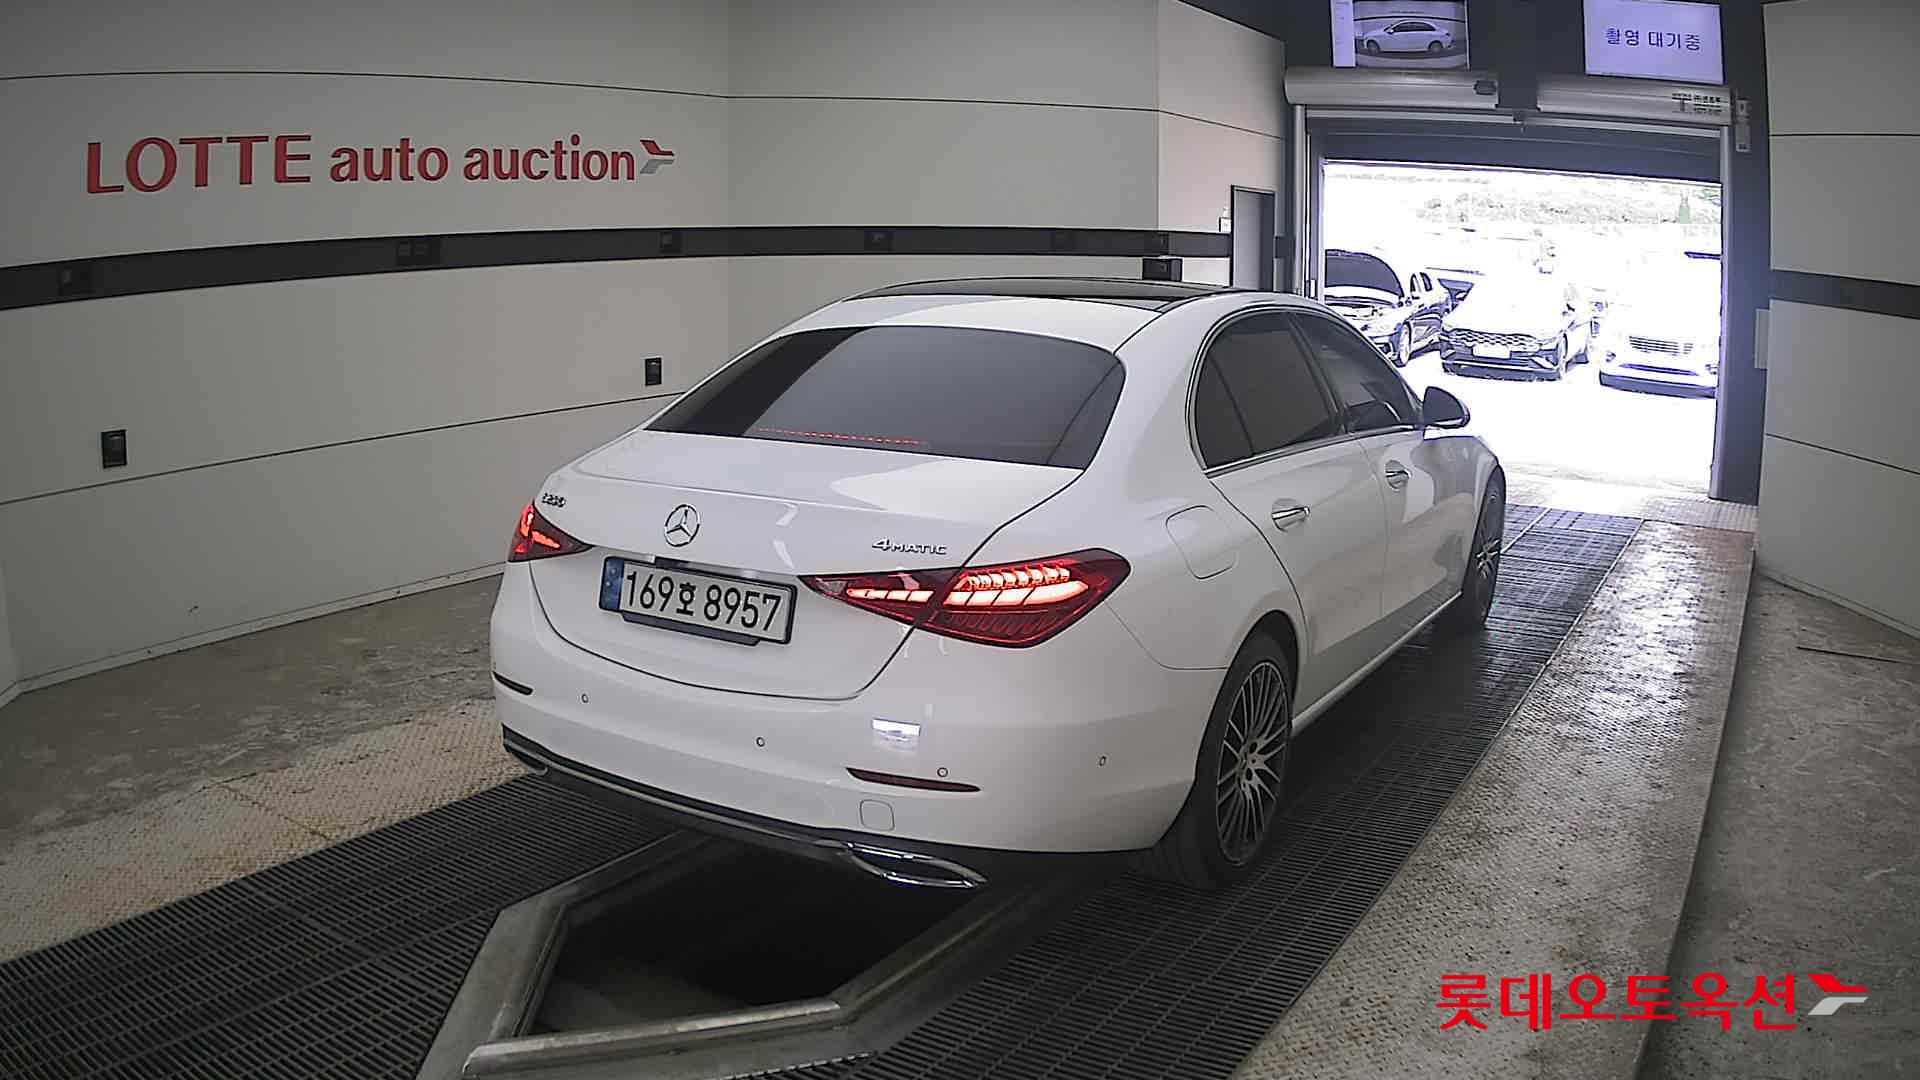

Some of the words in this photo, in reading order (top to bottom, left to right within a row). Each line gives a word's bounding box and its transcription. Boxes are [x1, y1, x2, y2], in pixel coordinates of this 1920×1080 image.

[1606, 27, 1640, 47] 촬영
[1648, 31, 1701, 51] 대기중
[86, 135, 312, 194] LOTTE
[330, 138, 449, 182] auto
[463, 134, 636, 181] auction
[871, 538, 947, 555] 4MATIC
